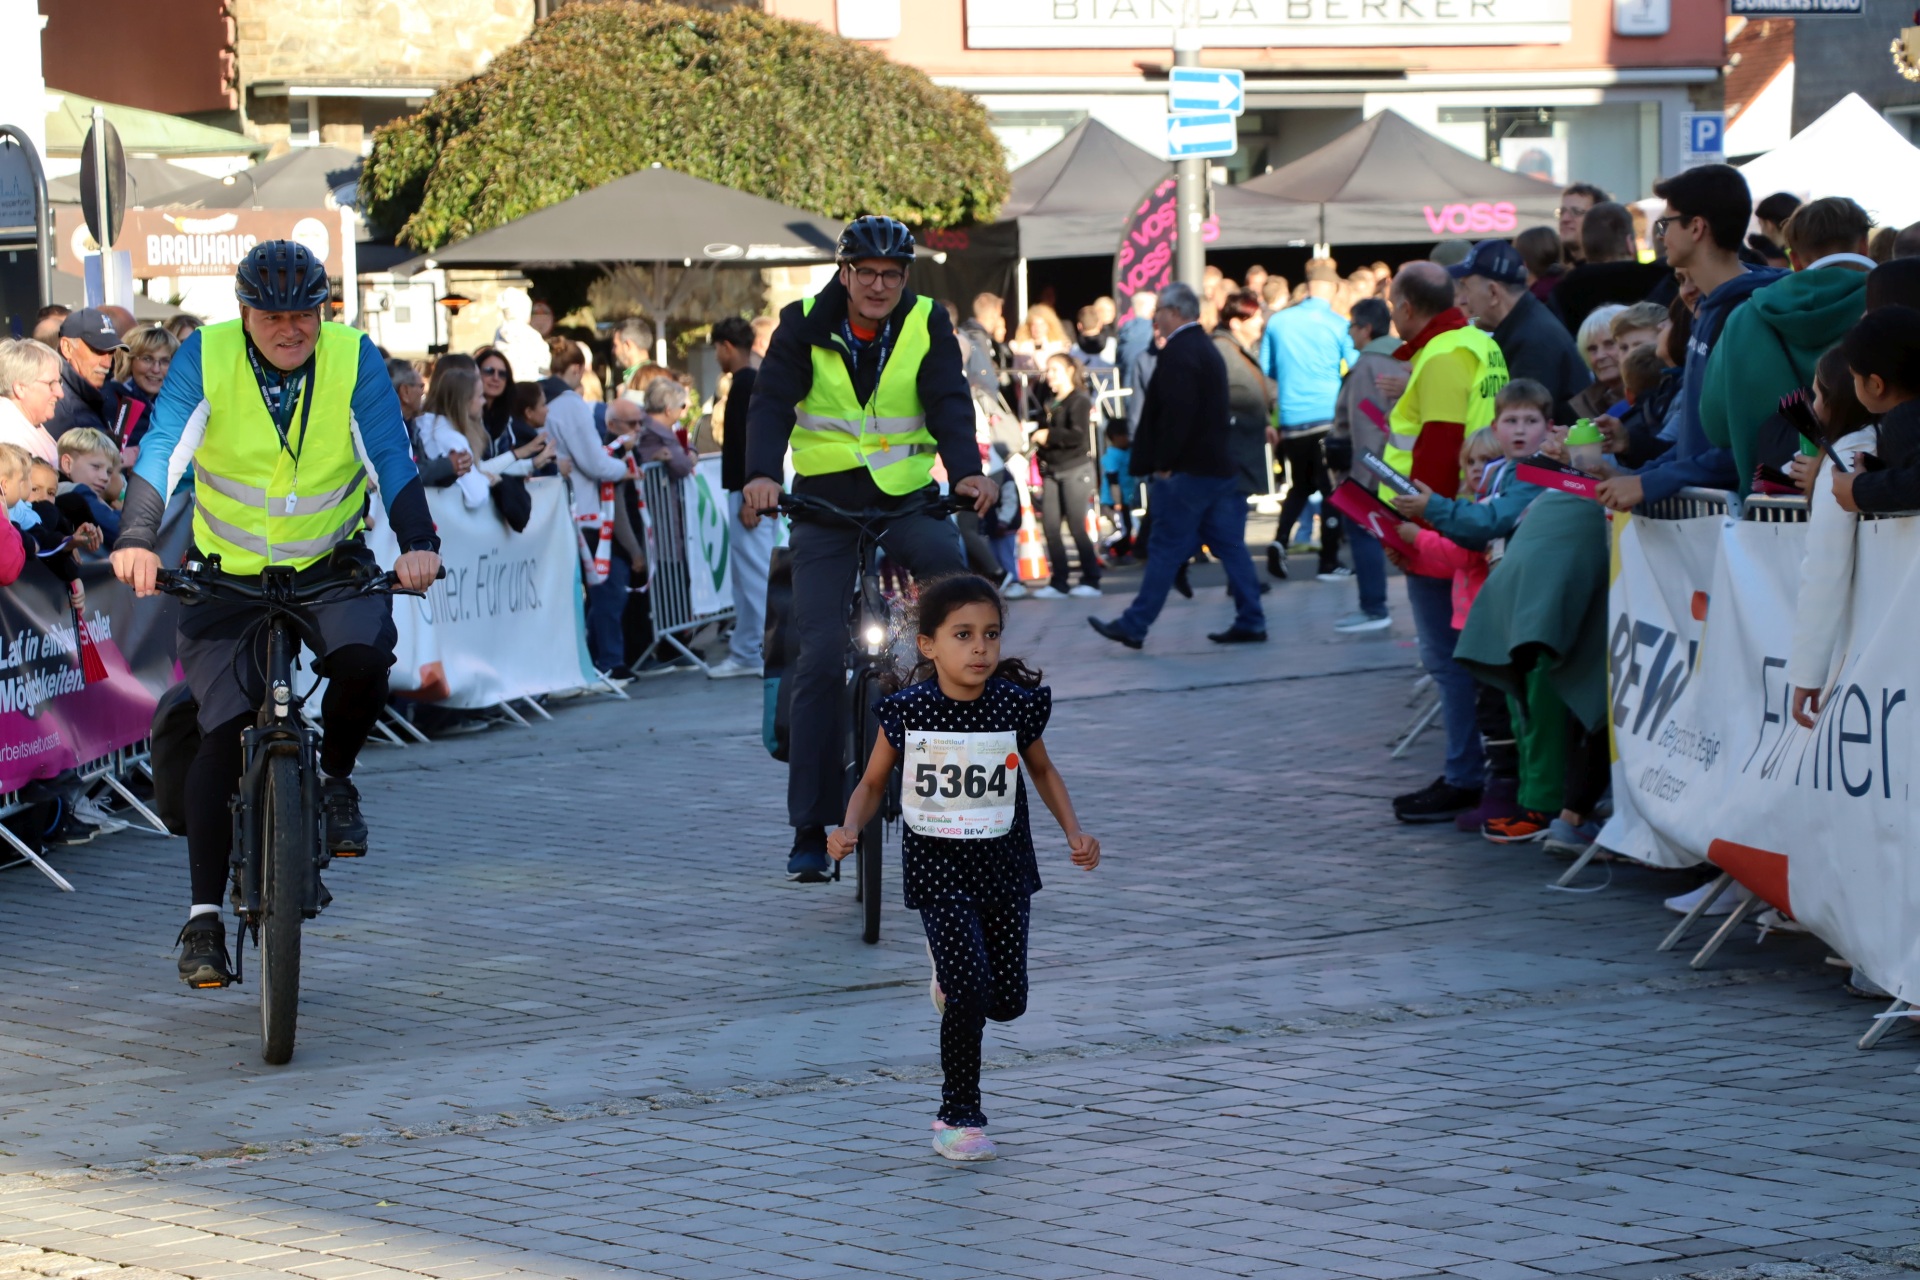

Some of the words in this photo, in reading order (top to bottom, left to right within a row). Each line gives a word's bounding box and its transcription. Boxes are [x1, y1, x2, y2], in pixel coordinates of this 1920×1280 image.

[1053, 0, 1258, 19] BIANA
[1697, 119, 1717, 150] P
[1423, 202, 1518, 234] VOSS
[147, 233, 258, 267] BRAUHAUS
[1117, 241, 1172, 297] VOSS
[1563, 479, 1586, 491] VOSS
[475, 547, 507, 618] Für
[508, 557, 543, 613] uns.
[25, 628, 40, 662] in
[915, 763, 1008, 798] 5364
[911, 824, 927, 832] AOK
[936, 827, 962, 835] VOSS
